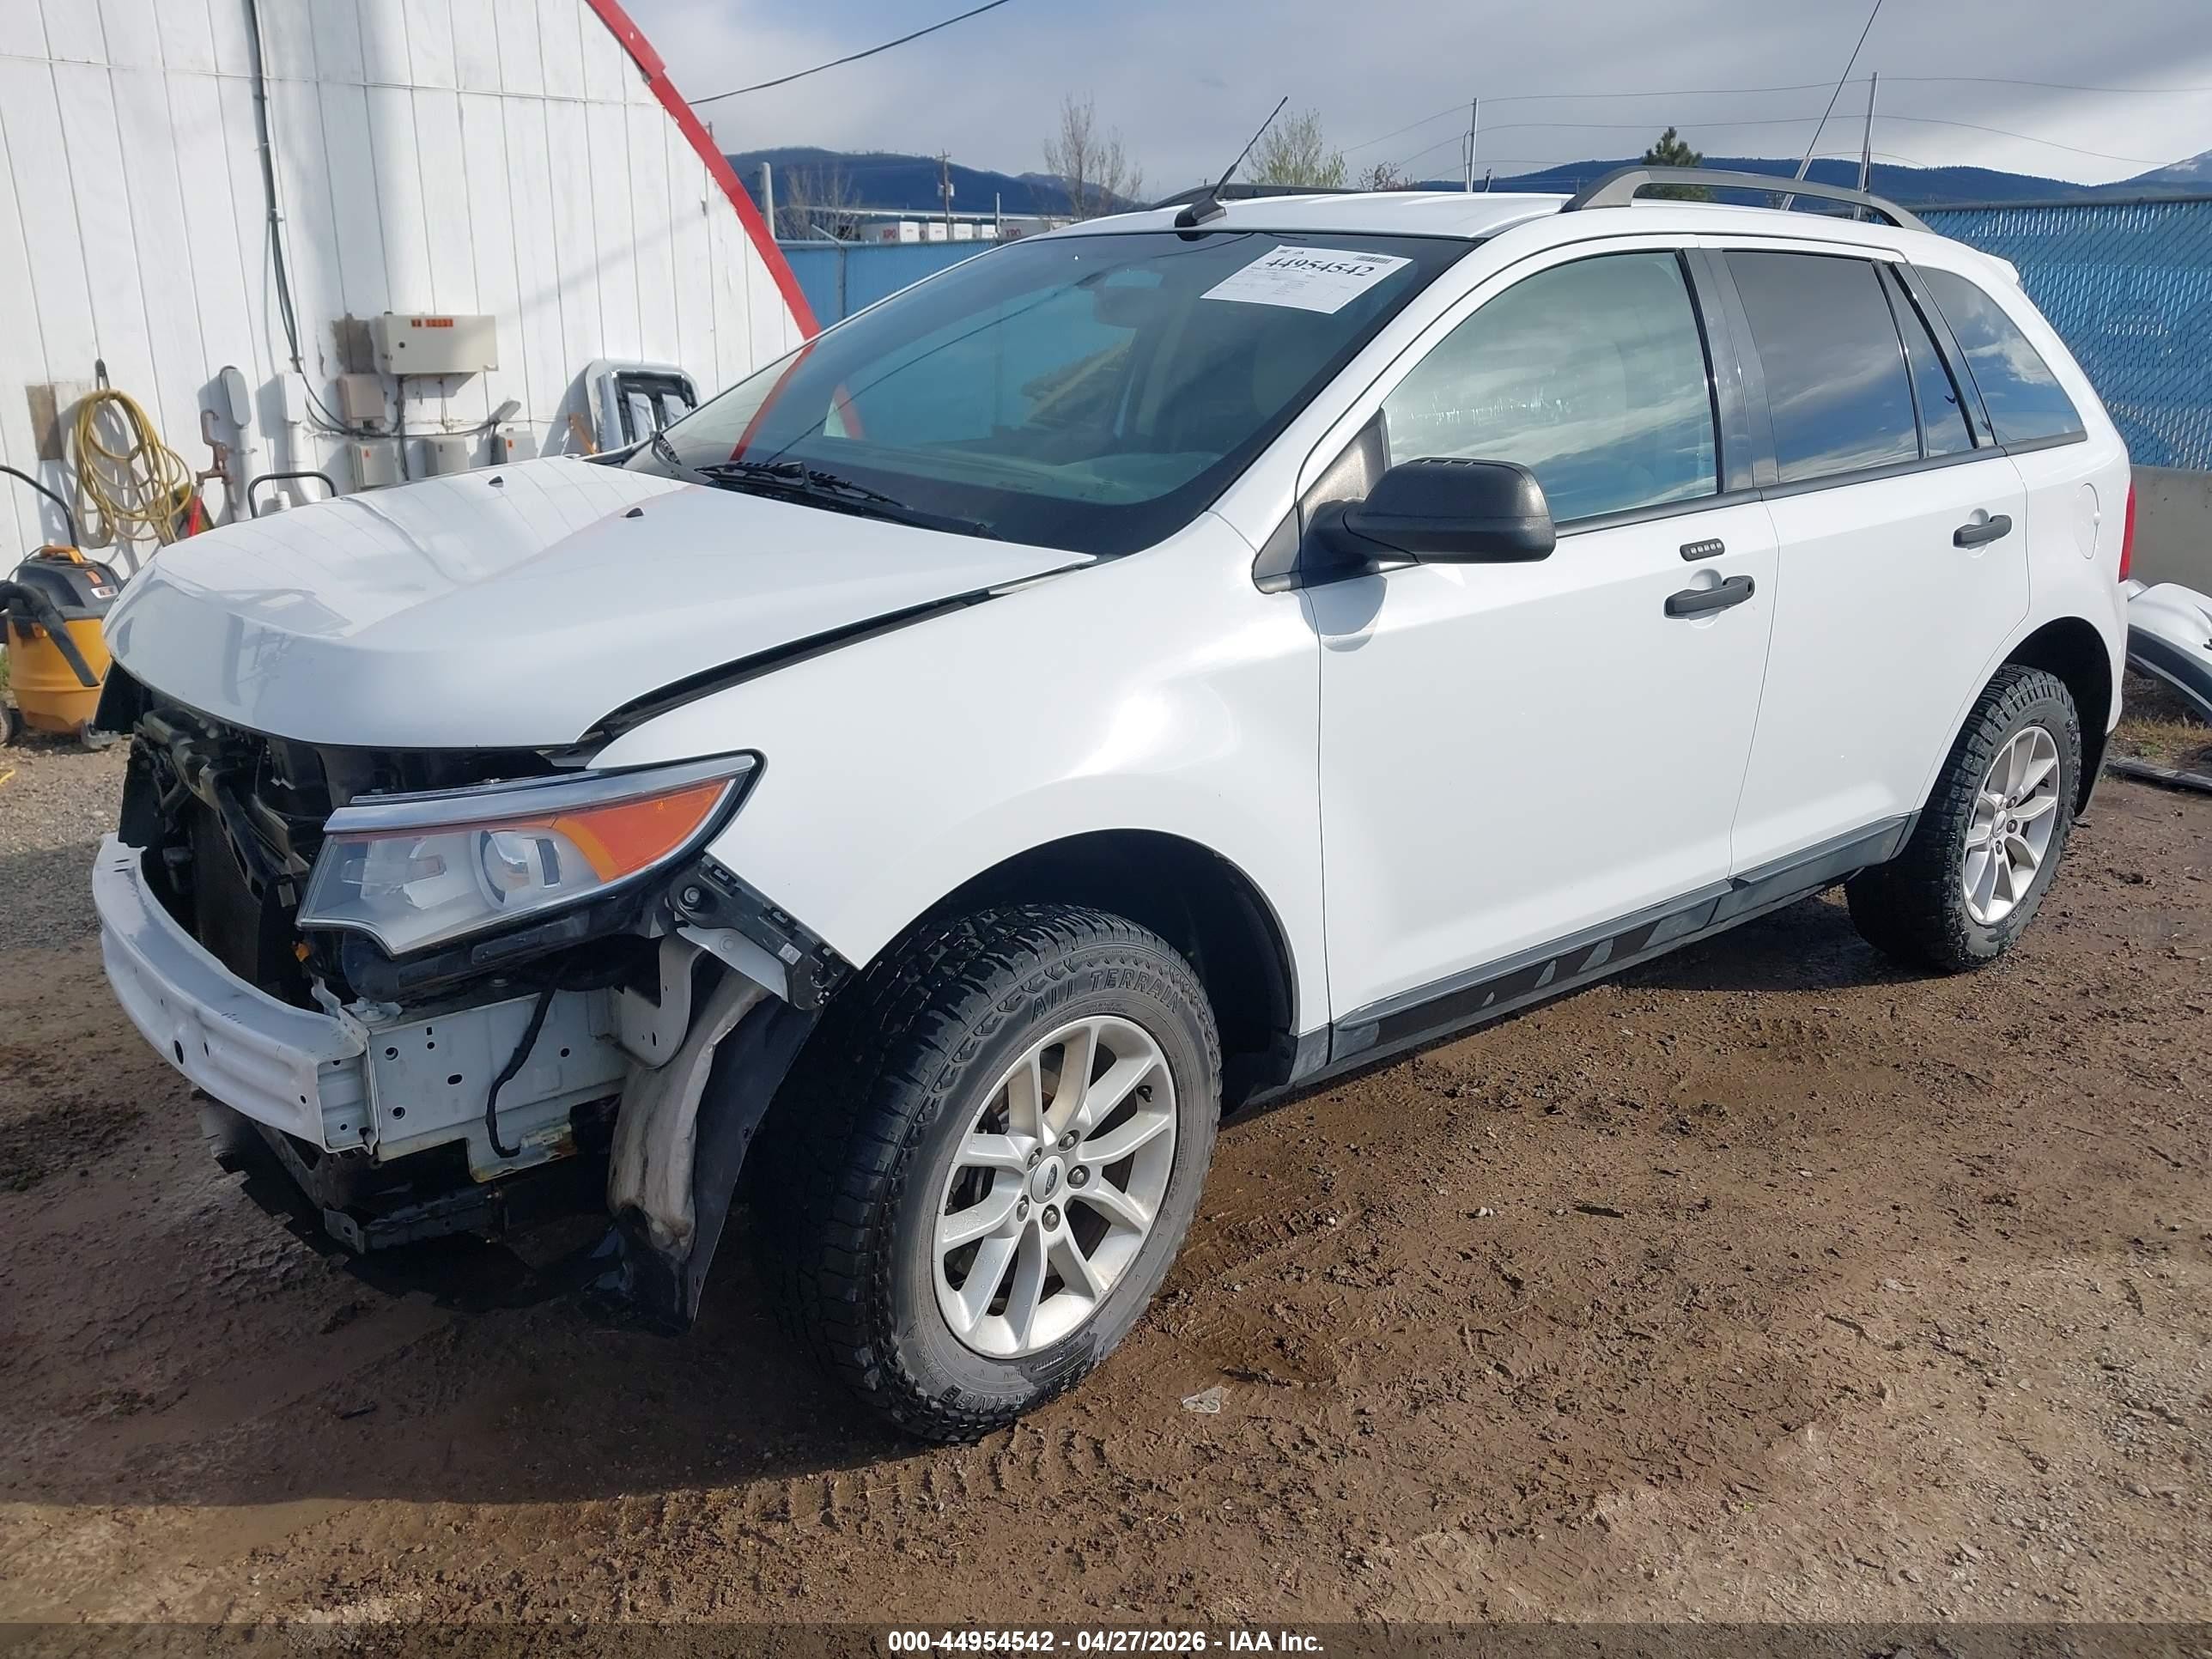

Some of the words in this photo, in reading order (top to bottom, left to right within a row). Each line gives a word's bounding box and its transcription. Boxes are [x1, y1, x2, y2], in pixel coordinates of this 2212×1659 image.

[1265, 257, 1375, 276] 44954542
[1031, 980, 1077, 1024] ALL
[1090, 968, 1183, 1014] TERRAIN
